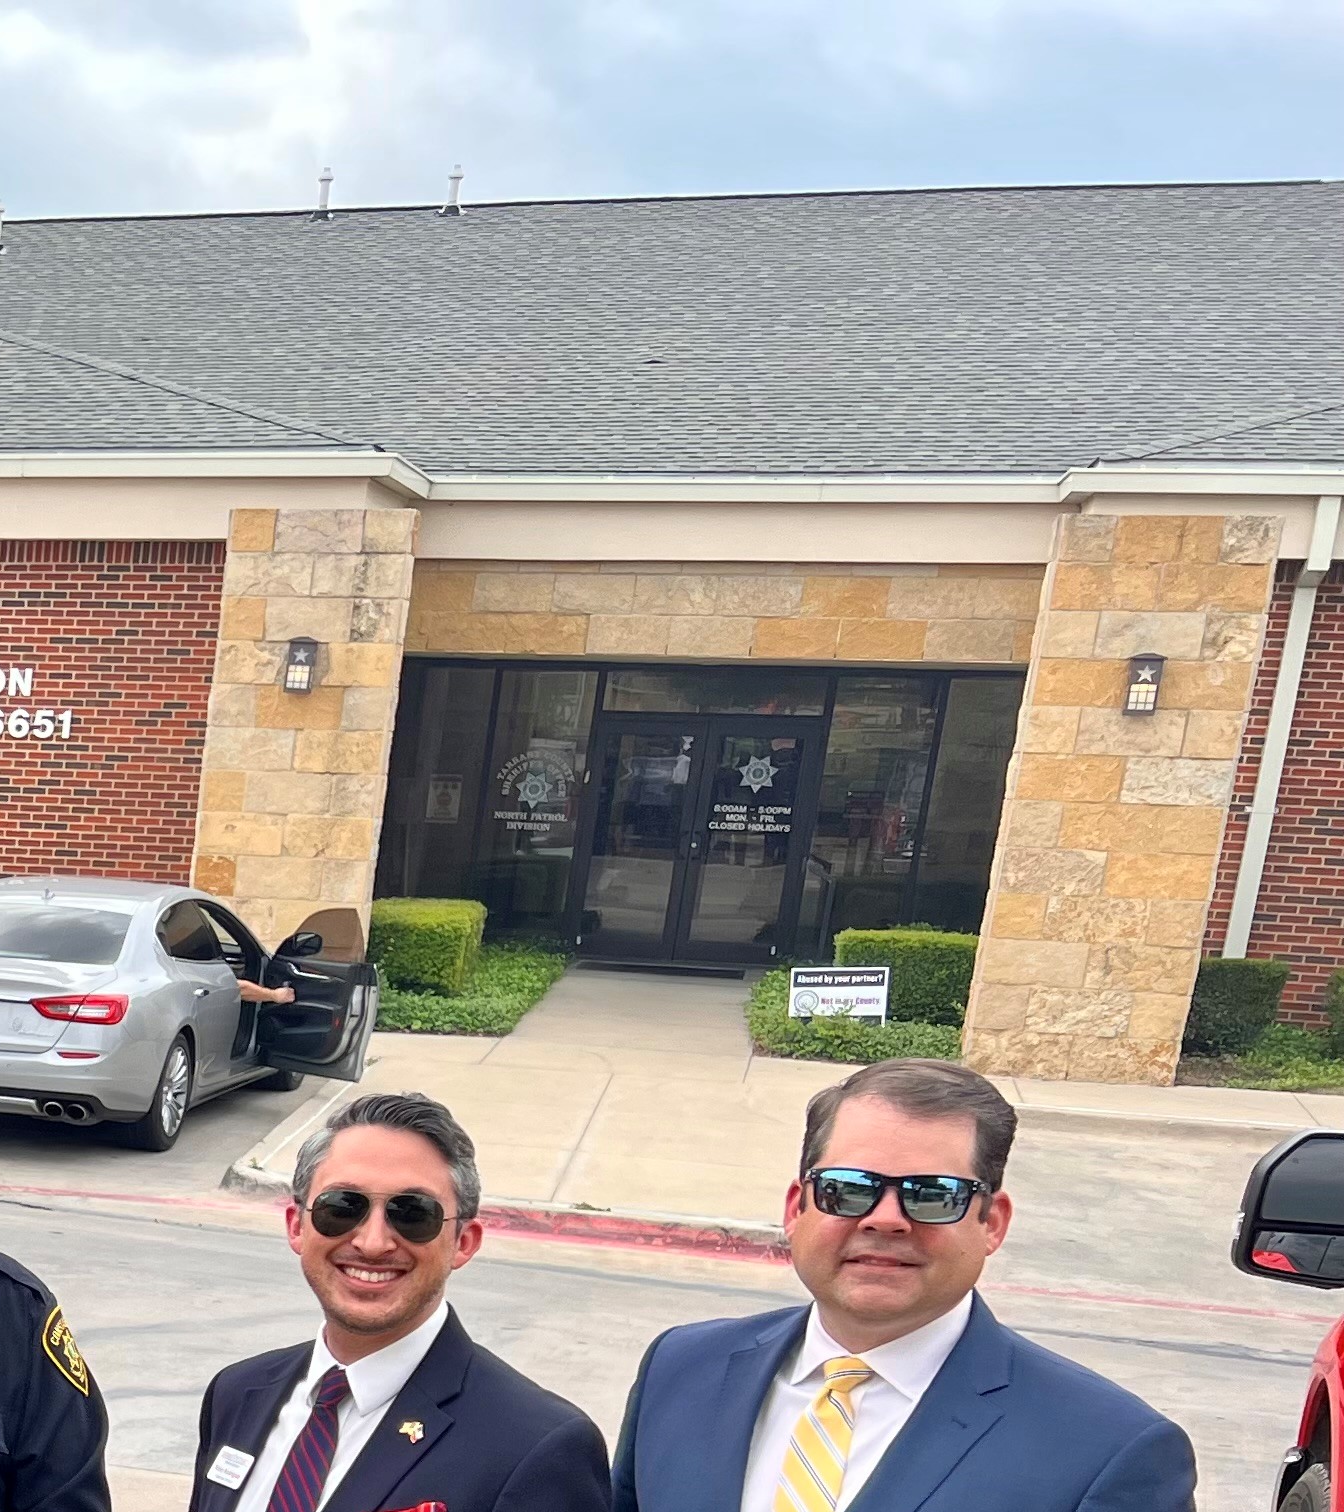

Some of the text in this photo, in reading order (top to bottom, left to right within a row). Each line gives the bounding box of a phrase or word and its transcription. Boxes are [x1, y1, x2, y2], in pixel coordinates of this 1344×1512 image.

[494, 811, 569, 823] NORTH PATROL
[506, 821, 551, 832] DIVISION
[708, 821, 791, 833] CLOSED HOLIDAYS
[797, 973, 883, 985] Abused by your partner?
